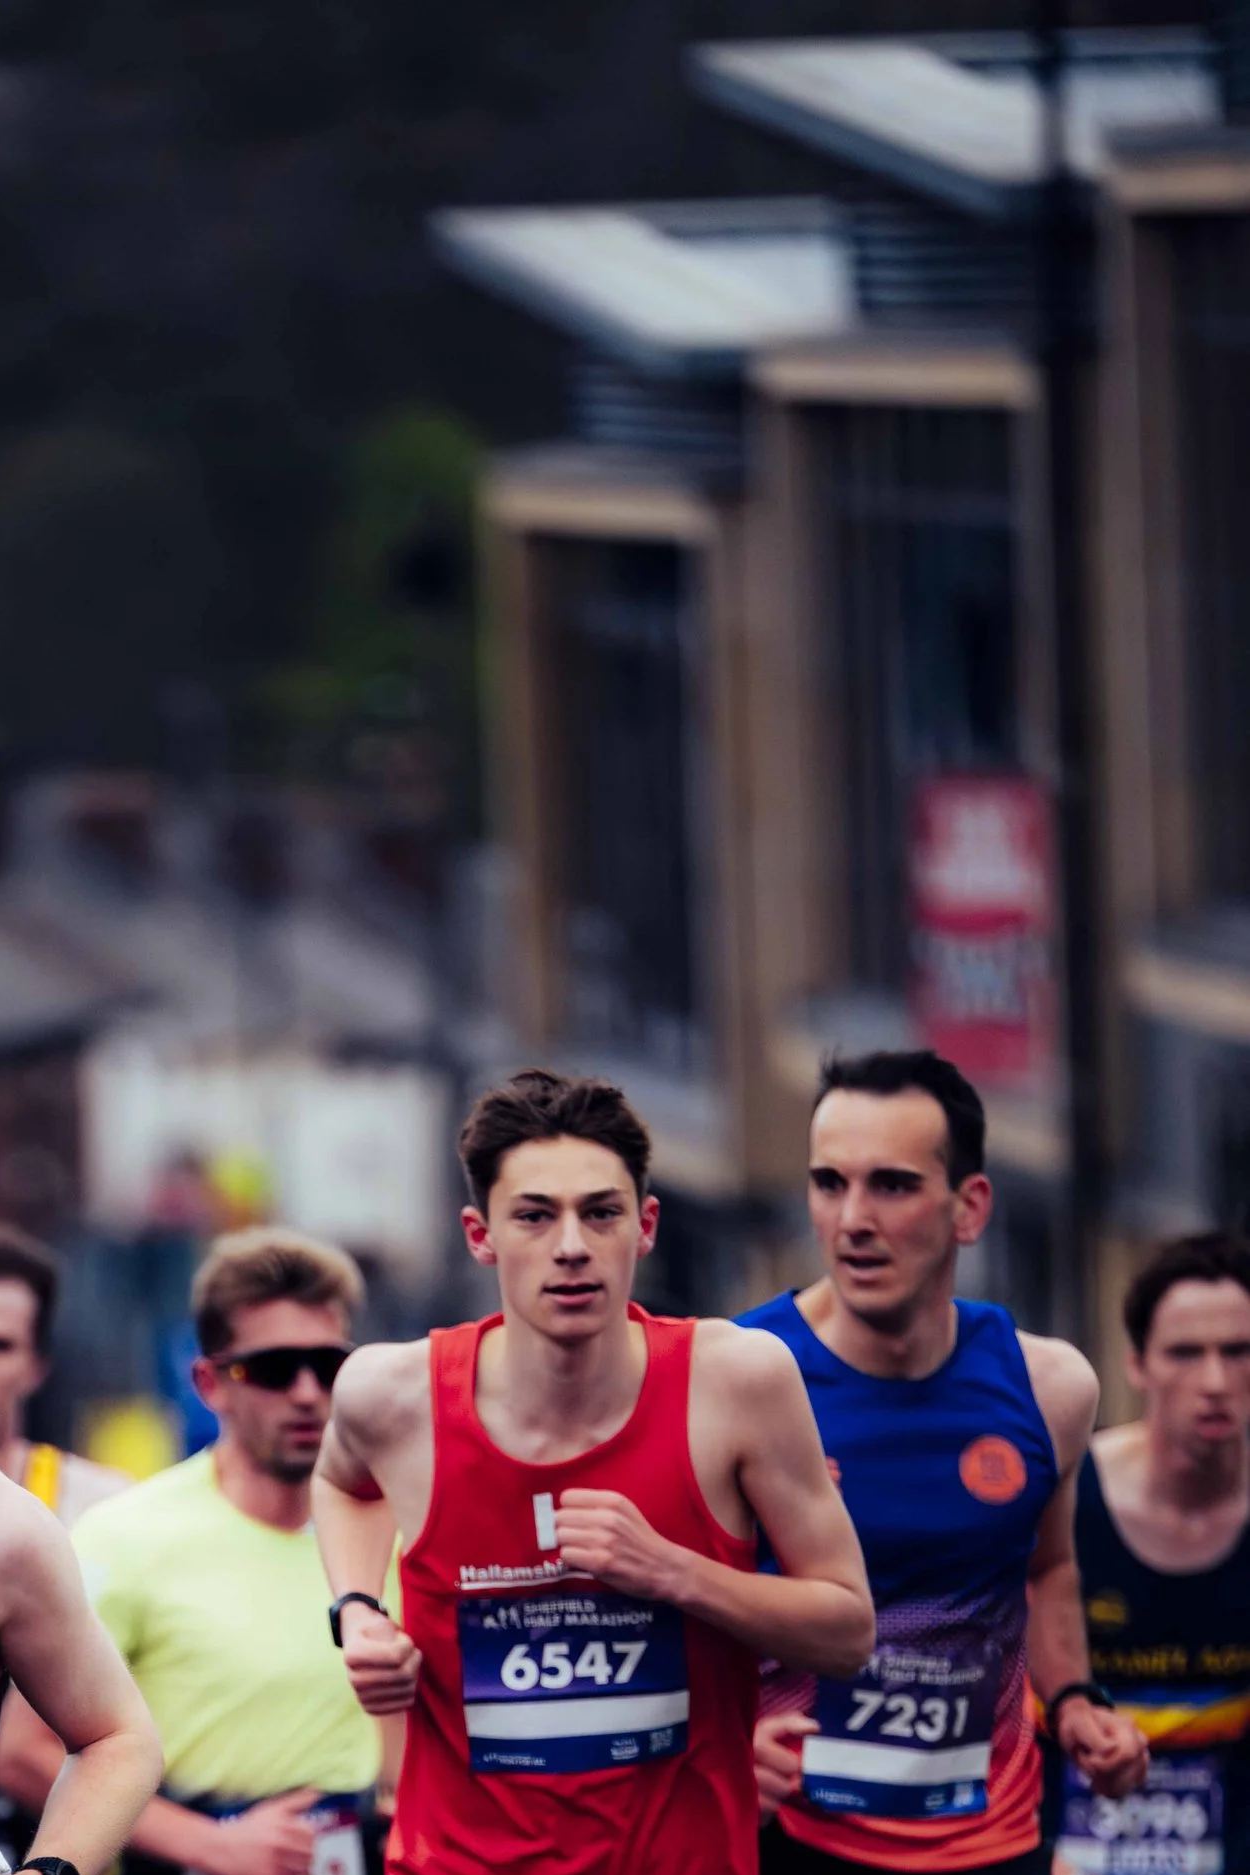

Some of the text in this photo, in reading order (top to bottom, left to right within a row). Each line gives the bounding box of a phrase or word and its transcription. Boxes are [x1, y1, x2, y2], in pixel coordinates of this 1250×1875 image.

[459, 1558, 564, 1581] Hallamshi
[500, 1640, 648, 1692] 6547
[847, 1688, 969, 1743] 7231
